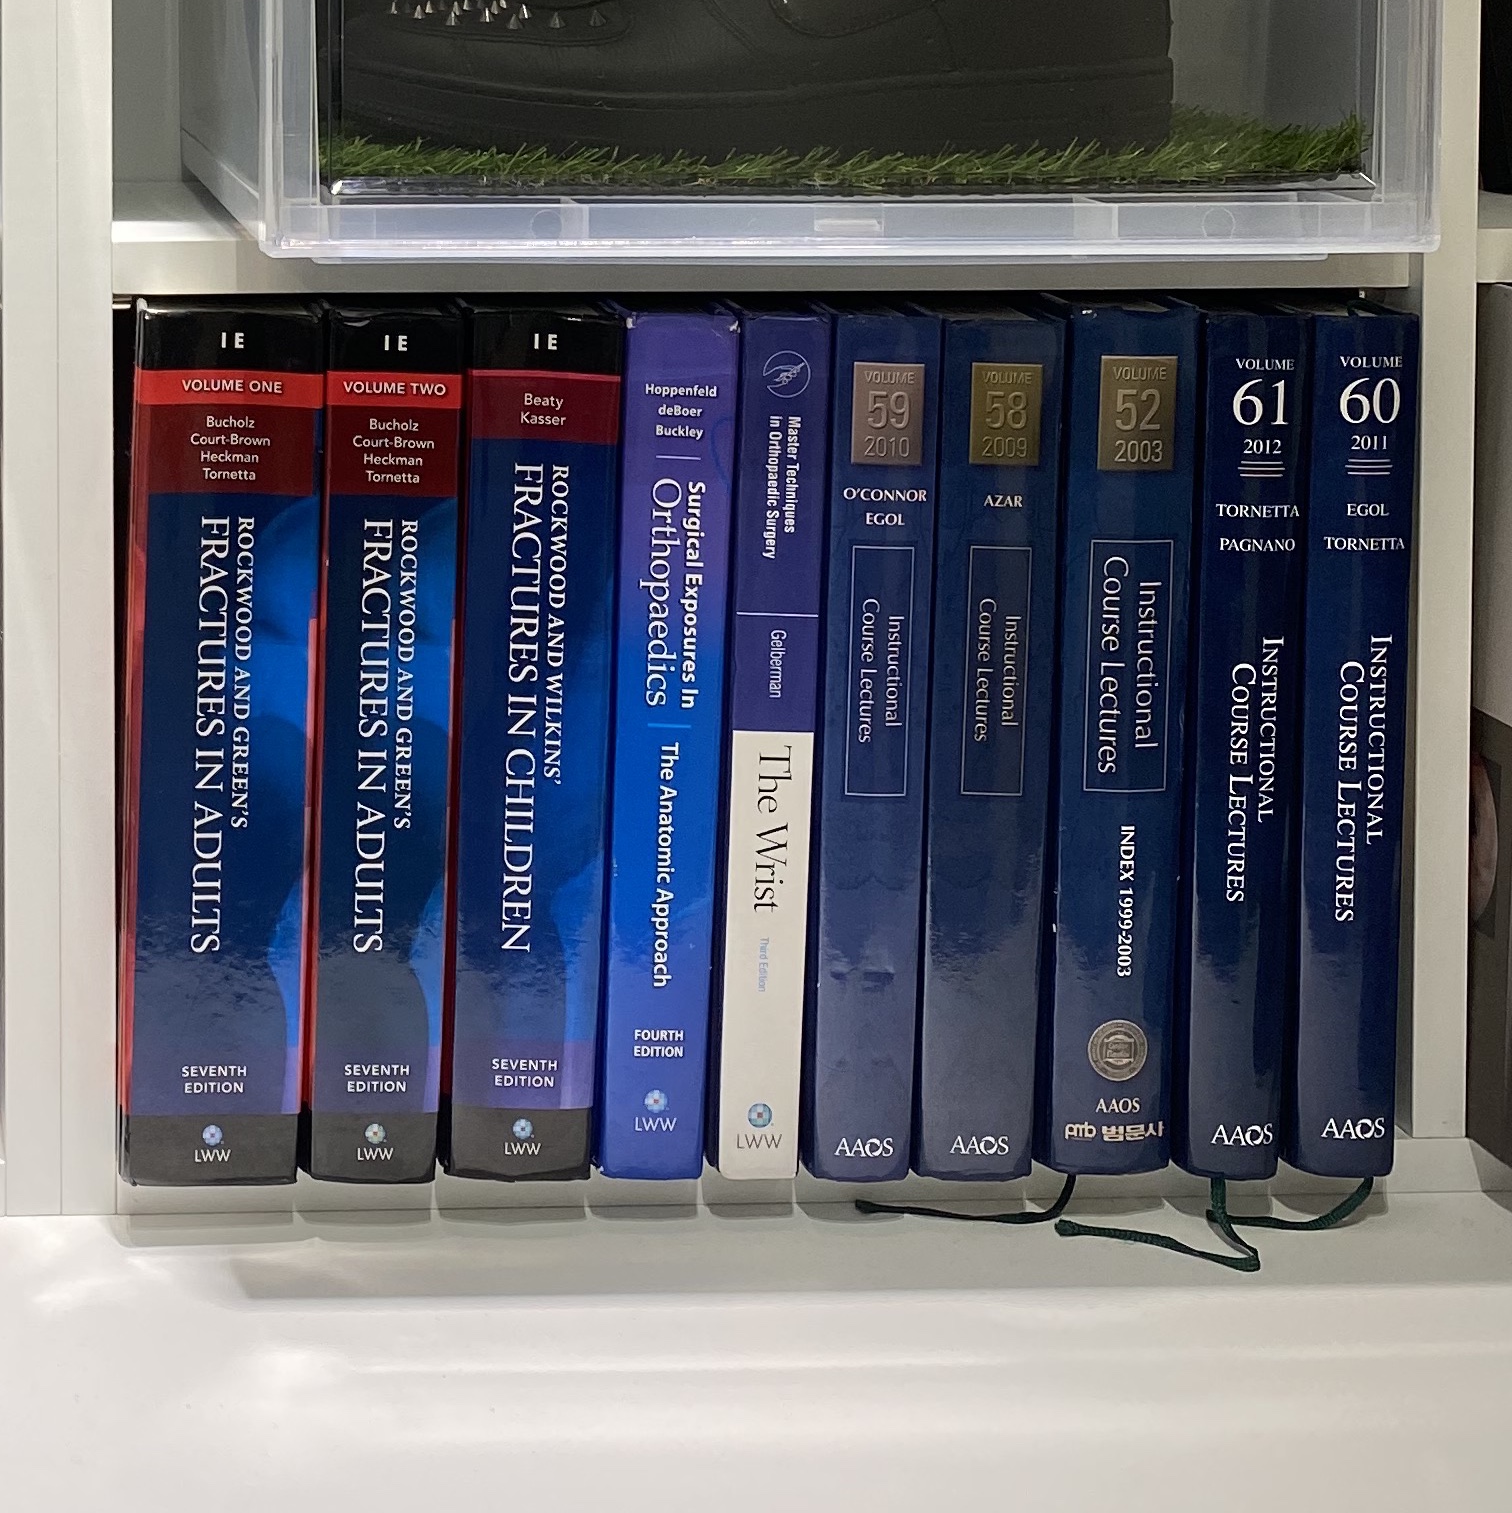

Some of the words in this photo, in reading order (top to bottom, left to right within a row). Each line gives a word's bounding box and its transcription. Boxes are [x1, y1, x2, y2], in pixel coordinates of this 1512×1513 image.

[864, 370, 915, 384] VOLUME
[1113, 366, 1167, 381] VOLUME
[1236, 358, 1295, 371] VOLUME
[1340, 356, 1403, 368] VOLUME
[182, 379, 244, 392] VOLUME
[249, 380, 283, 394] ONE
[343, 381, 405, 394] VOLUME
[410, 383, 446, 396] TWO
[645, 384, 718, 398] Hoppenfeld
[982, 371, 1032, 385] VOLUME
[524, 393, 564, 411] Beaty
[658, 405, 703, 417] deBoer
[867, 391, 910, 429] 59
[985, 391, 1027, 429] 58
[1115, 389, 1161, 431] 52
[1233, 378, 1288, 426] 61
[1340, 377, 1401, 424] 60
[206, 416, 255, 429] Bucholz
[369, 418, 419, 432] Bucholz
[520, 412, 567, 426] Kasser
[655, 425, 704, 440] Buckley
[769, 416, 782, 428] in
[190, 433, 271, 447] Court-Brown
[352, 436, 435, 450] Court-Brown
[787, 416, 802, 460] Master
[864, 436, 910, 458] 2010
[982, 436, 1027, 458] 2009
[1114, 440, 1163, 463] 2003
[1243, 439, 1282, 455] 2012
[1351, 435, 1387, 450] 2011
[200, 450, 259, 463] Heckman
[363, 453, 423, 467] Heckman
[766, 431, 782, 507] Orthopaedic
[202, 467, 256, 481] Tornetta
[365, 470, 420, 484] Tornetta
[784, 464, 800, 533] Techniques
[843, 488, 927, 502] O'CONNOR
[984, 495, 1023, 508] AZAR
[1346, 503, 1390, 517] EGOL
[681, 481, 706, 567] Surgical
[865, 513, 905, 525] EGOL
[1216, 504, 1299, 518] TORNETTA
[548, 464, 570, 609] ROCKWOOD
[763, 509, 780, 560] Surgery
[1219, 538, 1295, 552] PAGNANO
[1324, 537, 1405, 551] TORNETTA
[508, 462, 544, 683] FRACTURES
[235, 516, 255, 661] ROCKWOOD
[397, 520, 419, 662] ROCKWOOD
[639, 478, 682, 707] Orthopaedics
[1100, 556, 1129, 651] Course
[195, 516, 230, 737] FRACTURES
[358, 518, 393, 738] FRACTURES
[545, 613, 565, 668] AND
[679, 572, 704, 683] Exposures
[861, 598, 881, 663] Course
[977, 598, 997, 662] Course
[769, 629, 787, 699] Gelberman
[885, 616, 905, 727] Instructional
[1001, 616, 1022, 726] Instructional
[1135, 581, 1162, 748] Instructional
[233, 666, 250, 720] AND
[395, 667, 414, 721] AND
[681, 689, 699, 708] In
[858, 669, 878, 743] Lectures
[974, 668, 994, 742] Lectures
[506, 693, 538, 737] IN
[543, 672, 564, 785] WILKINS'
[1098, 662, 1126, 774] Lectures
[1229, 663, 1257, 765] COURSE
[1338, 661, 1365, 771] COURSE
[1258, 636, 1284, 823] INSTRUCTIONAL
[1366, 634, 1393, 845] INSTRUCTIONAL
[194, 747, 225, 792] IN
[357, 749, 387, 793] IN
[659, 742, 679, 781] The
[230, 726, 249, 828] GREEN'S
[393, 727, 413, 830] GREEN'S
[757, 745, 793, 814] The
[656, 785, 678, 884] Anatomic
[1226, 773, 1254, 902] LECTURES
[501, 749, 537, 953] CHILDREN
[1119, 825, 1136, 881] INDEX
[1335, 780, 1362, 922] LECTURES
[190, 800, 224, 953] ADULTS
[353, 801, 387, 953] ADULTS
[753, 823, 789, 913] Wrist
[650, 888, 675, 988] Approach
[1117, 887, 1134, 977] 1999-2003
[634, 1029, 684, 1042] FOURTH
[491, 1058, 558, 1071] SEVENTH
[633, 1046, 684, 1057] EDITION
[181, 1065, 247, 1078] SEVENTH
[344, 1064, 410, 1076] SEVENTH
[494, 1075, 554, 1087] EDITION
[184, 1082, 244, 1094] EDITION
[347, 1081, 406, 1093] EDITION
[1095, 1098, 1140, 1113] AAOS
[635, 1117, 677, 1132] LWW
[1102, 1121, 1164, 1142] 범문사
[1211, 1124, 1273, 1146] AAOS
[1321, 1118, 1385, 1139] AAOS
[194, 1149, 231, 1162] LWW
[357, 1147, 394, 1161] LWW
[504, 1142, 542, 1155] LWW
[737, 1134, 782, 1149] LWW
[834, 1138, 894, 1157] AAOS
[950, 1136, 1009, 1155] AAOS
